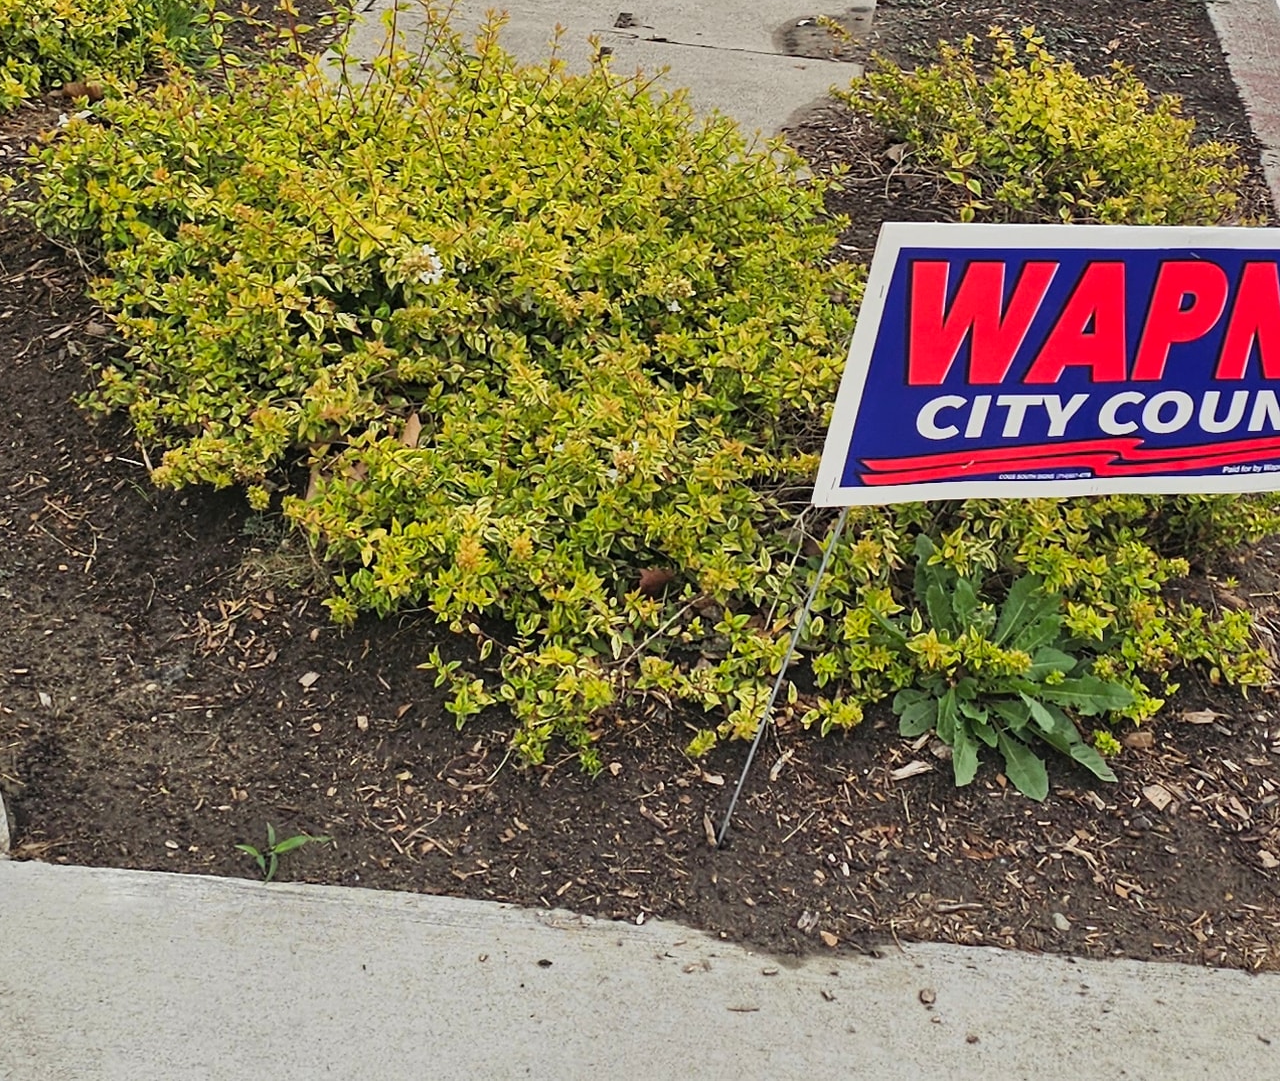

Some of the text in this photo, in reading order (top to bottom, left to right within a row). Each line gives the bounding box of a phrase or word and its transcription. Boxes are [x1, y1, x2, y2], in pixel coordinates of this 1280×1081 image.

[916, 393, 1090, 440] CITY
[1222, 465, 1240, 474] Paid
[1241, 464, 1252, 473] for
[1252, 464, 1263, 473] by
